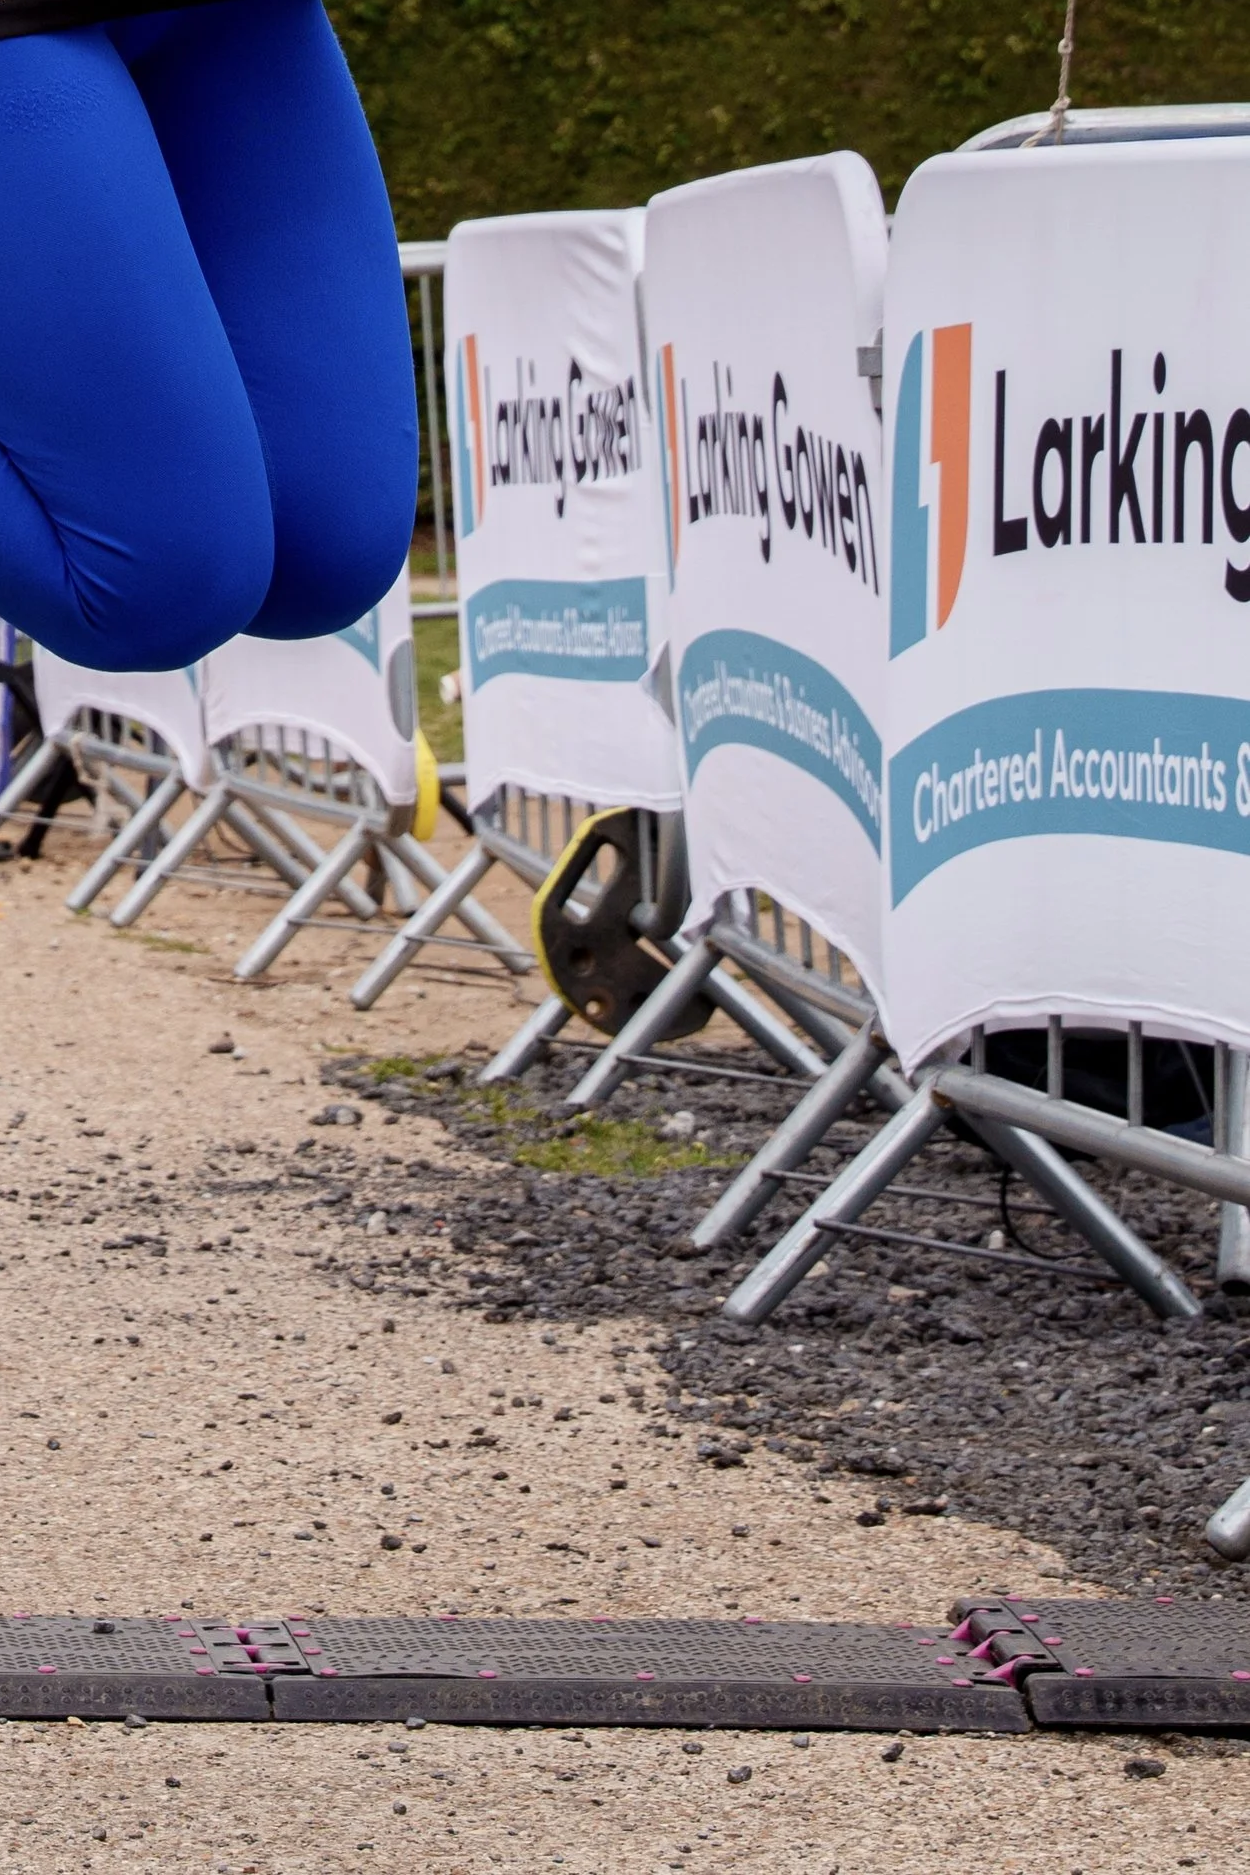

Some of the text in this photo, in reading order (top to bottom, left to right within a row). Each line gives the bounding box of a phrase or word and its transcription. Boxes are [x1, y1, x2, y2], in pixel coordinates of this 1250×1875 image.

[484, 356, 642, 519] Larking Gowen
[681, 360, 880, 598] Larking Gowen
[993, 348, 1250, 603] Larking
[913, 727, 1042, 843] Chartered
[1049, 728, 1226, 812] Accountants
